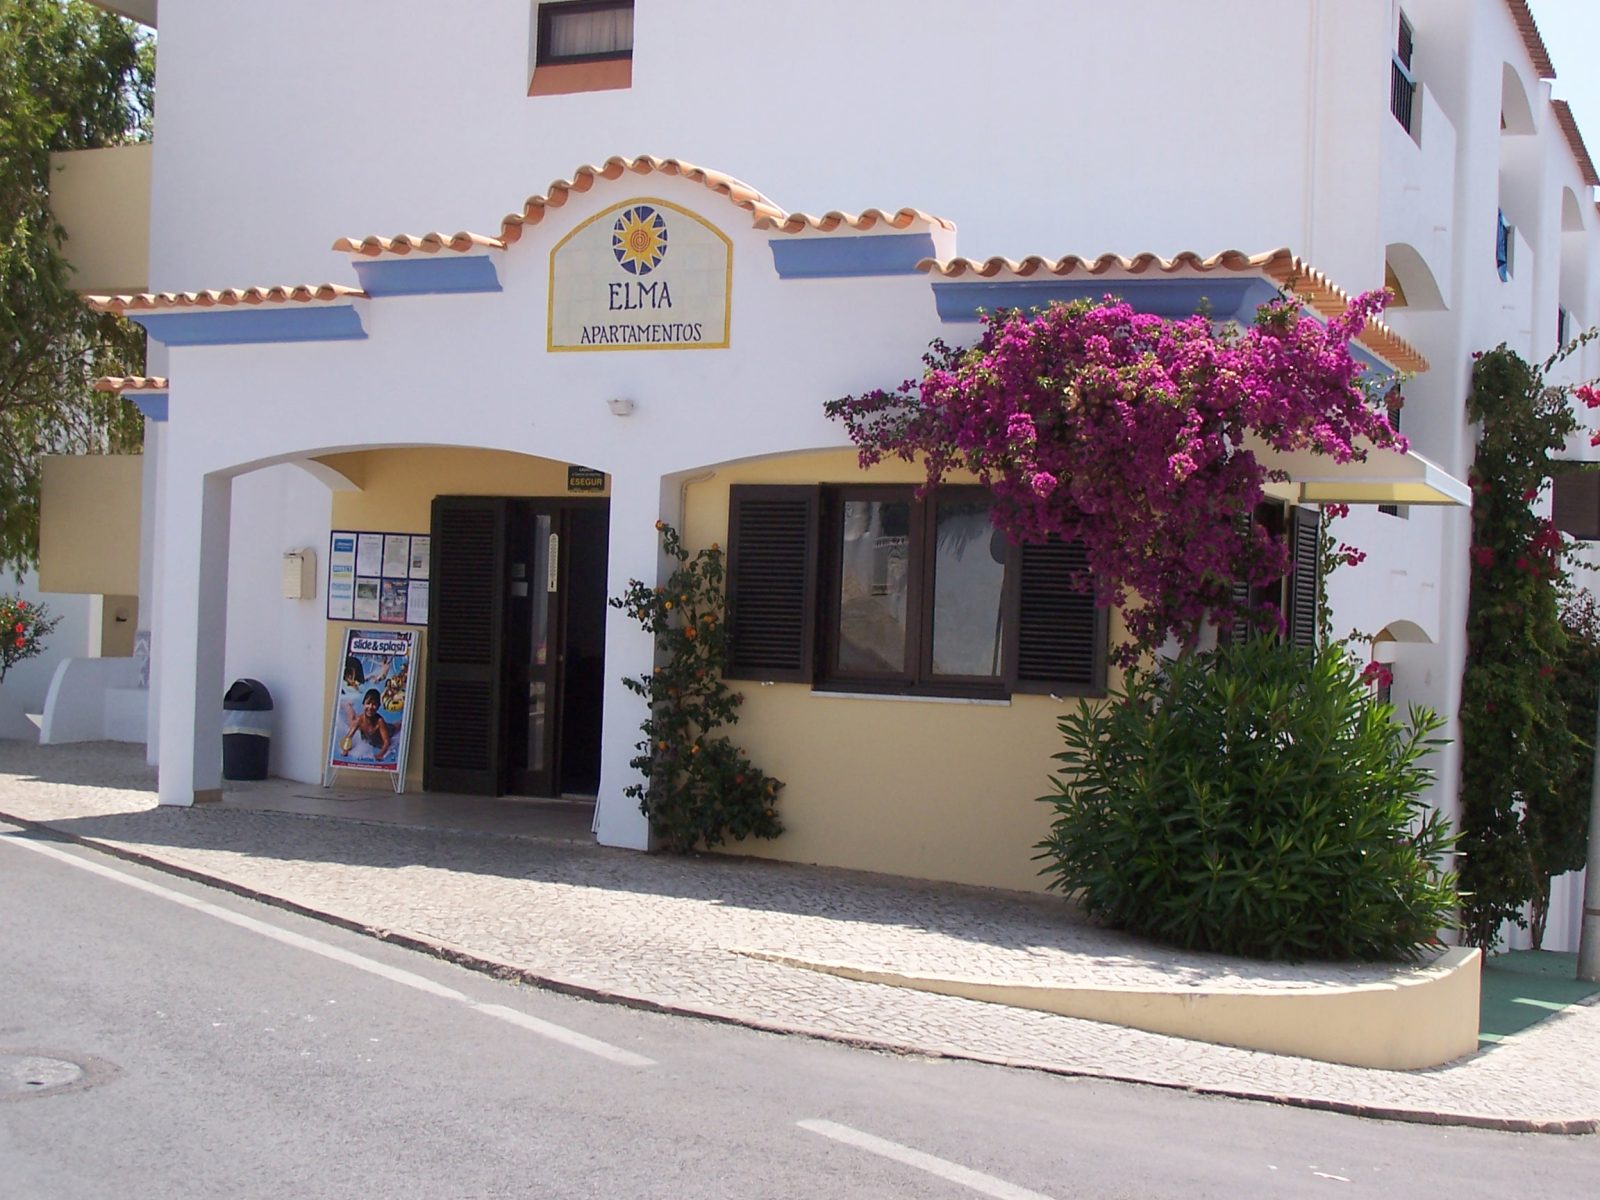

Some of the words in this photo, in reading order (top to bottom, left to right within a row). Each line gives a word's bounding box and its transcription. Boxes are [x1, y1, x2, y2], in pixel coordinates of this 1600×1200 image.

[608, 281, 672, 310] ELMA
[581, 323, 702, 344] APARTAMENTOS
[570, 477, 602, 486] ESEGUR
[353, 639, 372, 650] slide
[372, 641, 379, 651] &
[379, 640, 406, 653] splash
